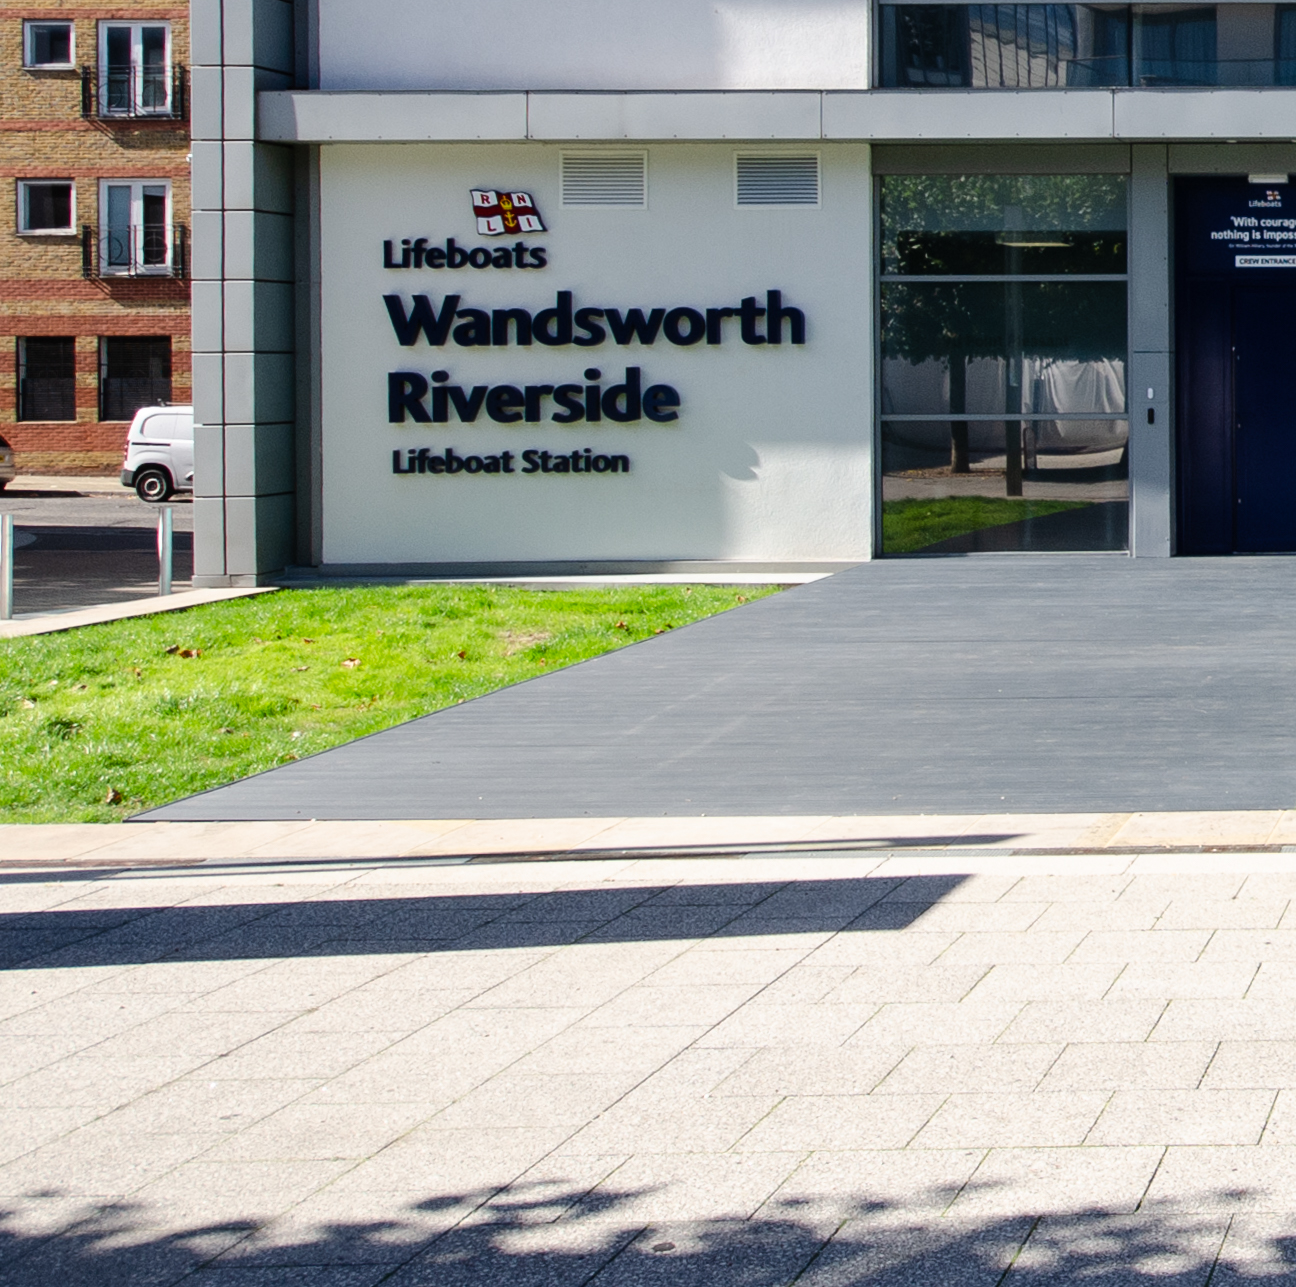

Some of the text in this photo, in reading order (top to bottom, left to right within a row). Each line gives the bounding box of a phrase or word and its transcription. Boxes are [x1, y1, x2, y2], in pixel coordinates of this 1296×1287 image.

[481, 194, 527, 205] R N
[486, 219, 497, 232] L
[1211, 230, 1250, 242] nothing
[1252, 230, 1261, 239] is
[383, 238, 547, 269] Lifeboats
[383, 290, 806, 347] Wandsworth
[388, 367, 681, 424] Riverside
[392, 448, 630, 475] Lifeboat Station
